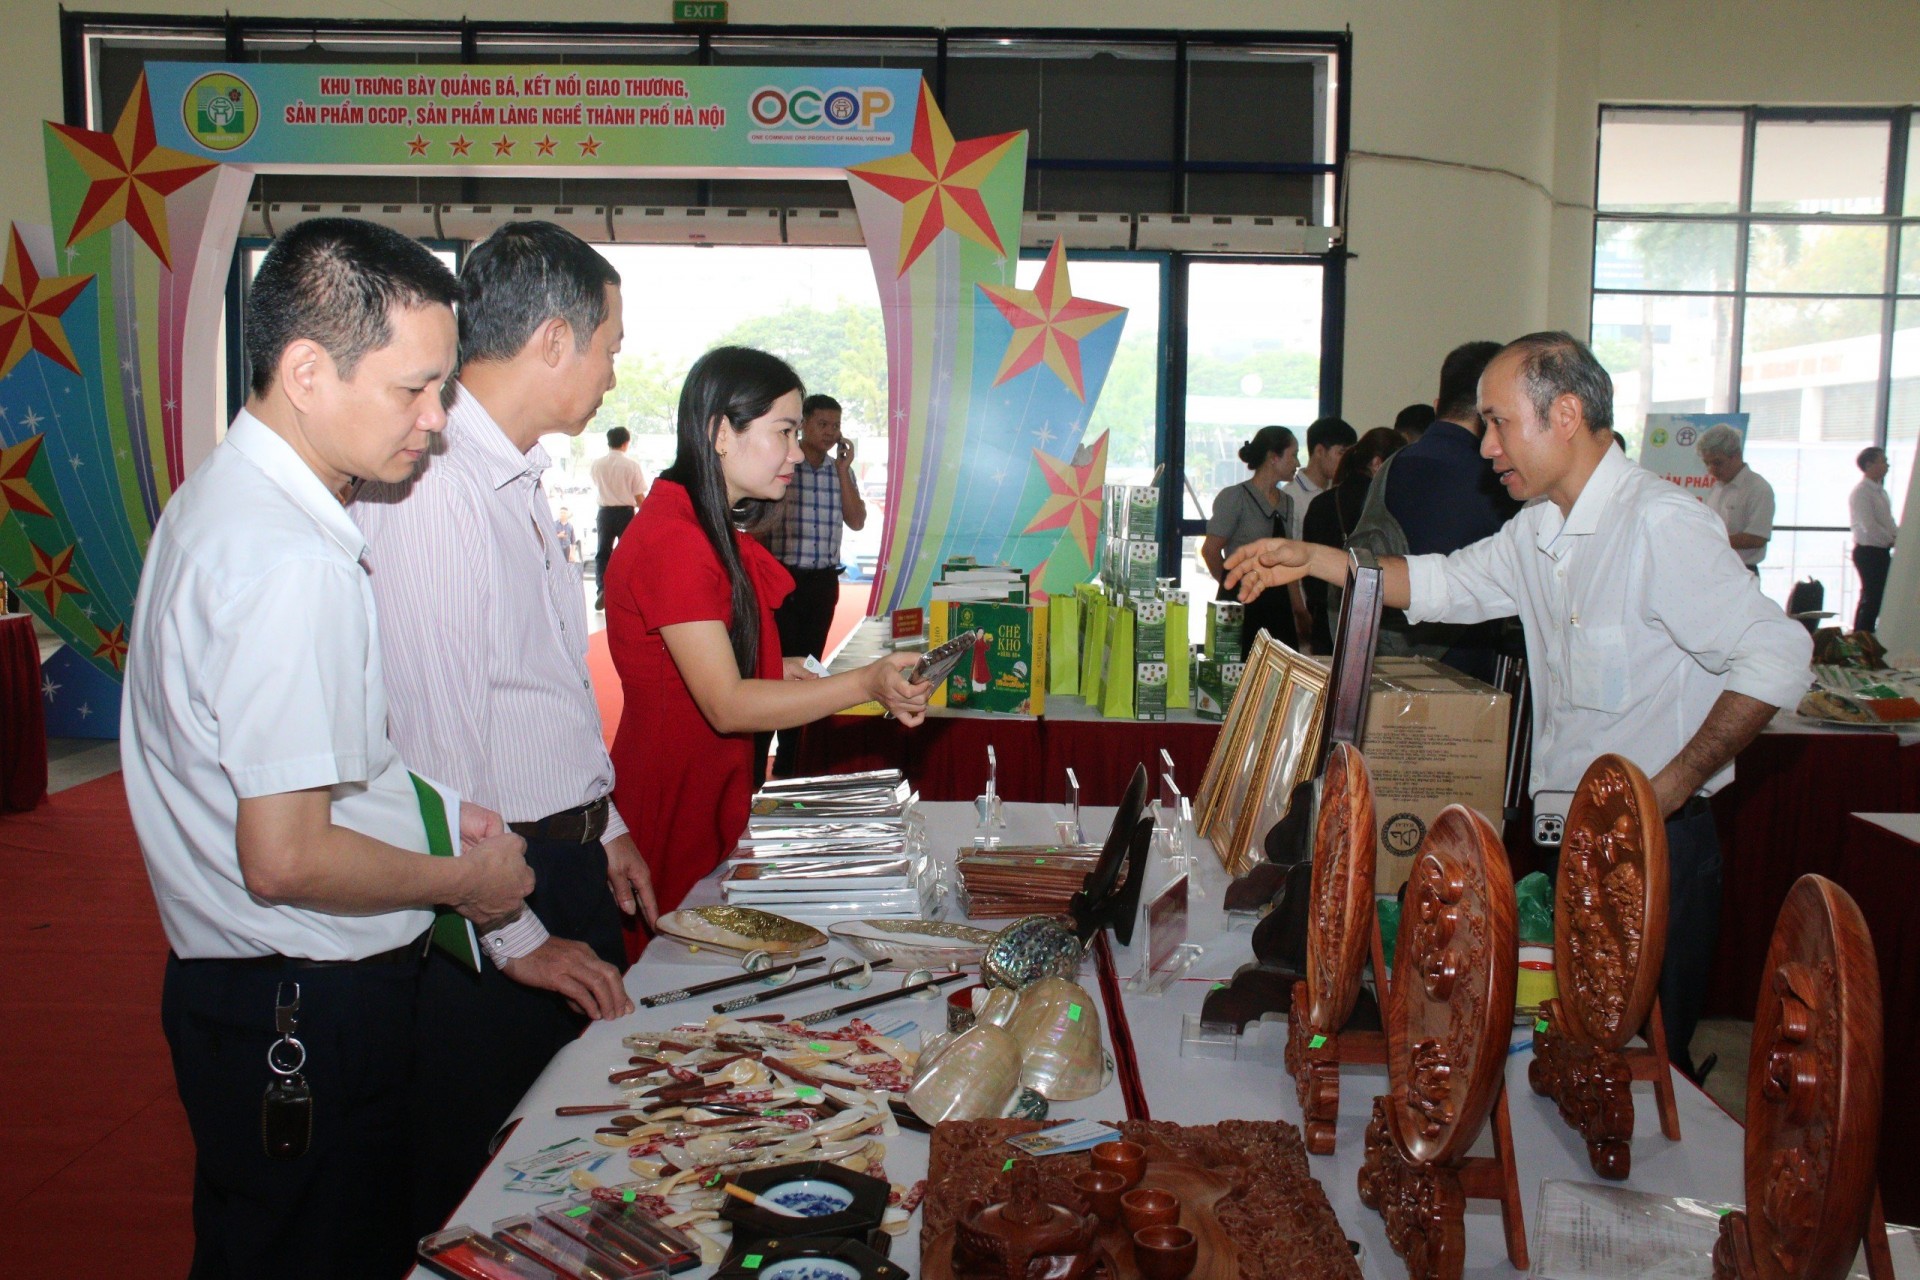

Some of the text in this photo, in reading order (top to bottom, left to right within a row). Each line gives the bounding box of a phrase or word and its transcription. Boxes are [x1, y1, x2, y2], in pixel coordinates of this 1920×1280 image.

[684, 4, 717, 18] EXIT
[320, 73, 689, 98] KHU TRƯNG BÀY QUẢNG BÁ, KẾT NỐI GIAO THƯƠNG,
[285, 100, 725, 129] SẢN PHẨM OCOP, SẢN PHẨM LÀNG NGHỀ THÀNH PHỐ HÀ NỘI
[751, 89, 892, 127] OCOP
[998, 624, 1021, 639] CHÈ
[998, 637, 1021, 652] KHO
